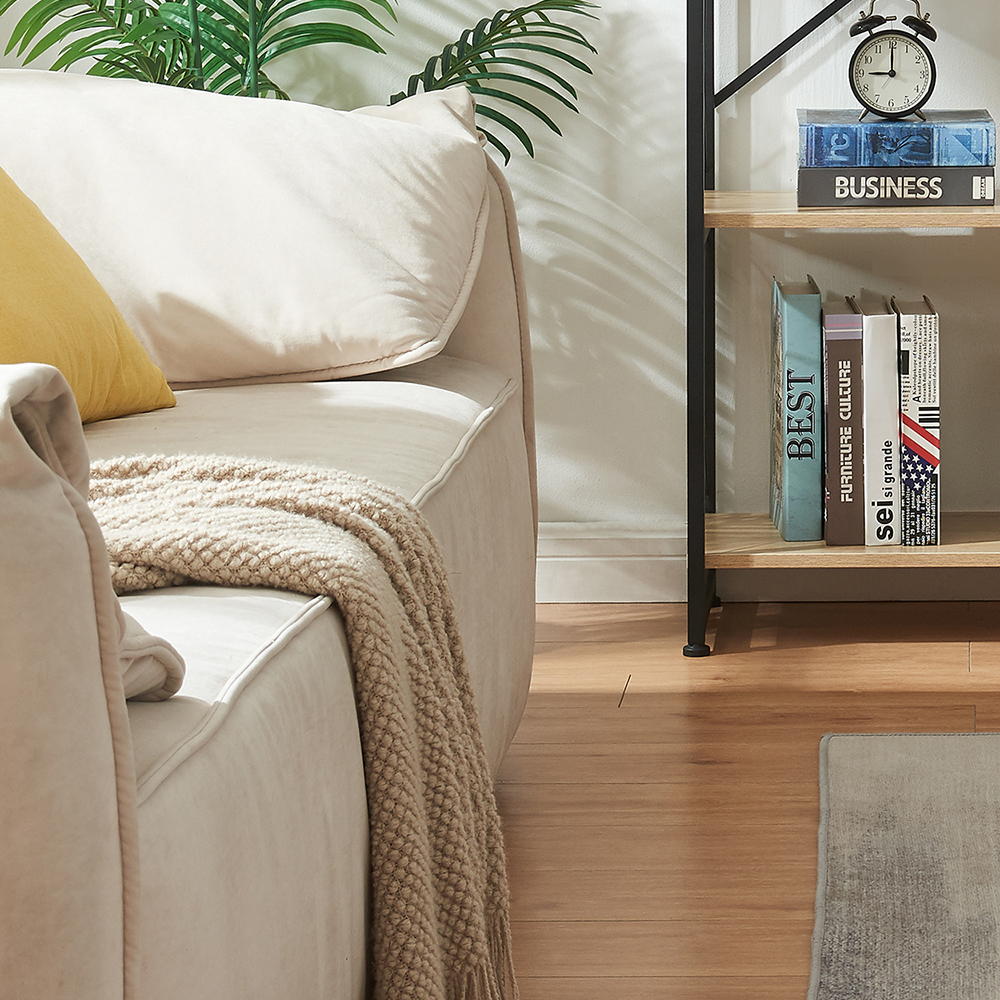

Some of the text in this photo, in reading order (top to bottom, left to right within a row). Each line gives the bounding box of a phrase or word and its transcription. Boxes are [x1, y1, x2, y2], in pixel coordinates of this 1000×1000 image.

[875, 45, 882, 53] 11
[888, 41, 898, 49] 12
[905, 45, 910, 53] 1
[864, 55, 872, 64] 10
[915, 56, 921, 64] 2
[859, 69, 864, 77] 9
[920, 71, 925, 79] 3
[863, 84, 869, 92] 8
[914, 85, 920, 93] 4
[875, 95, 880, 103] 7
[888, 99, 894, 107] 6
[904, 96, 910, 104] 5
[834, 176, 944, 200] BUSINESS
[838, 360, 852, 420] CULTURE
[786, 368, 816, 460] BEST
[871, 440, 895, 540] sei si grande
